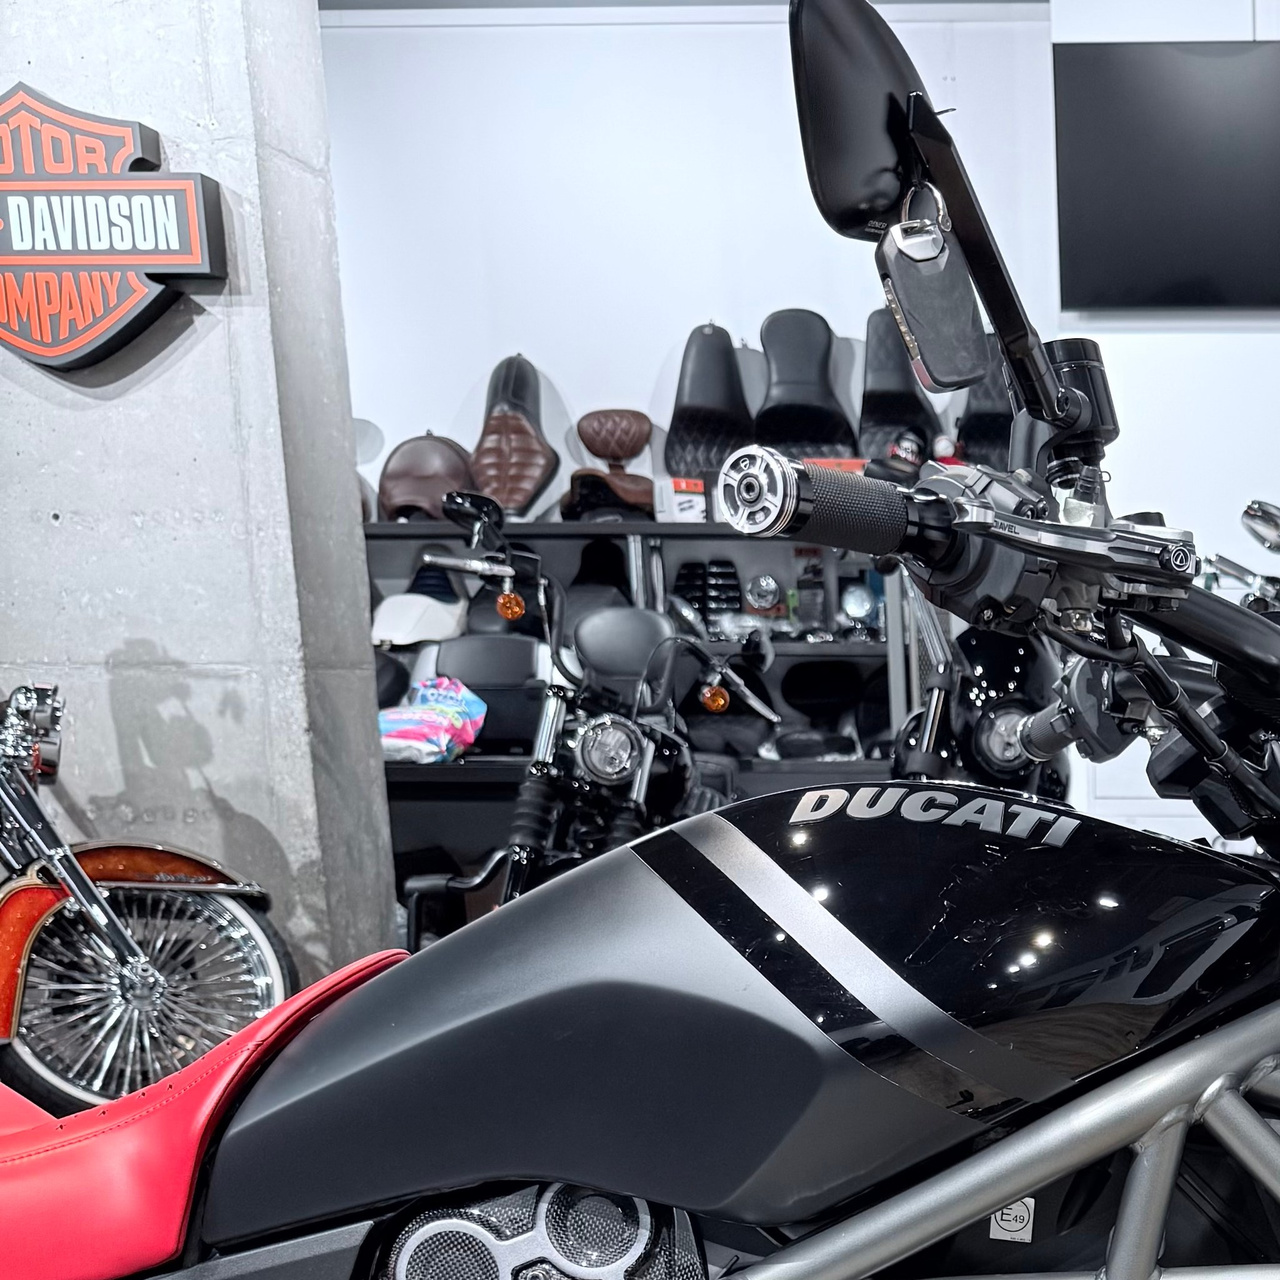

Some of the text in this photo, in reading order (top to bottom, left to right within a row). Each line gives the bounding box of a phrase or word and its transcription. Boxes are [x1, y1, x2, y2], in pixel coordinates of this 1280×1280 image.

[7, 194, 181, 251] DAVIDSON
[0, 270, 121, 344] MPANY
[789, 786, 1082, 849] DUCATI
